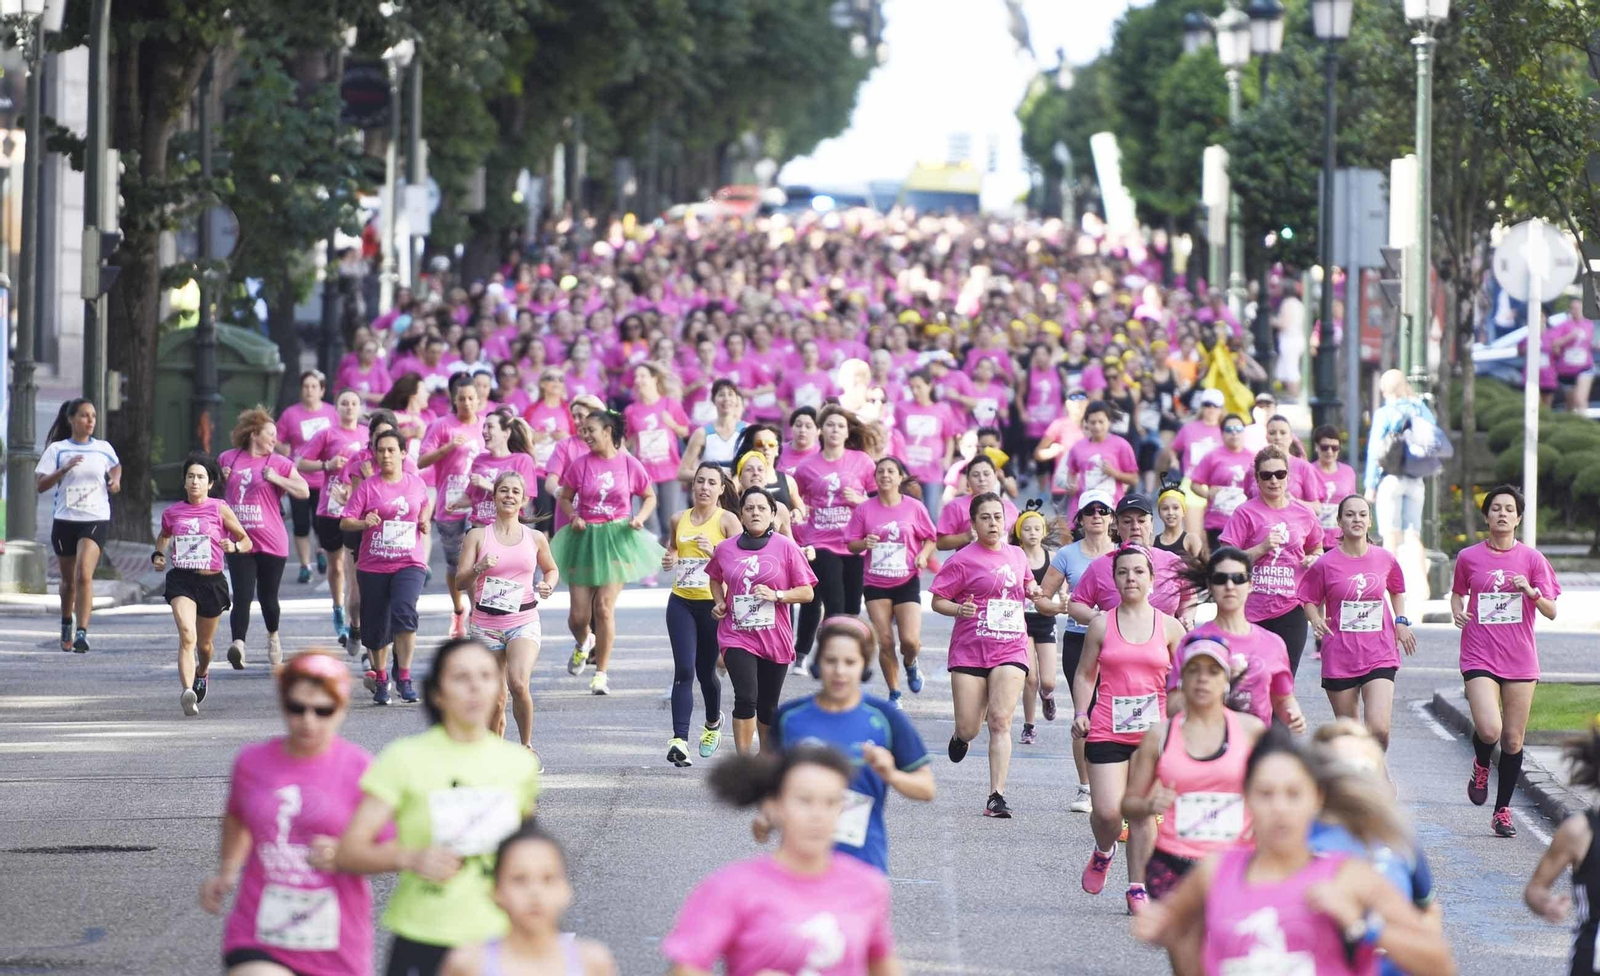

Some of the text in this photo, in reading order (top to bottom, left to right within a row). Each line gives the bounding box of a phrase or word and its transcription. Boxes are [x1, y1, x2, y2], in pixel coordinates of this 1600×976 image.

[685, 567, 700, 575] 222
[1252, 565, 1295, 577] CARRERA
[1251, 574, 1296, 587] FEMENINA
[499, 588, 507, 597] 12
[748, 604, 760, 613] 357
[1494, 602, 1508, 611] 442
[1002, 610, 1014, 618] 482
[1357, 611, 1368, 619] 444
[1132, 708, 1142, 717] 68
